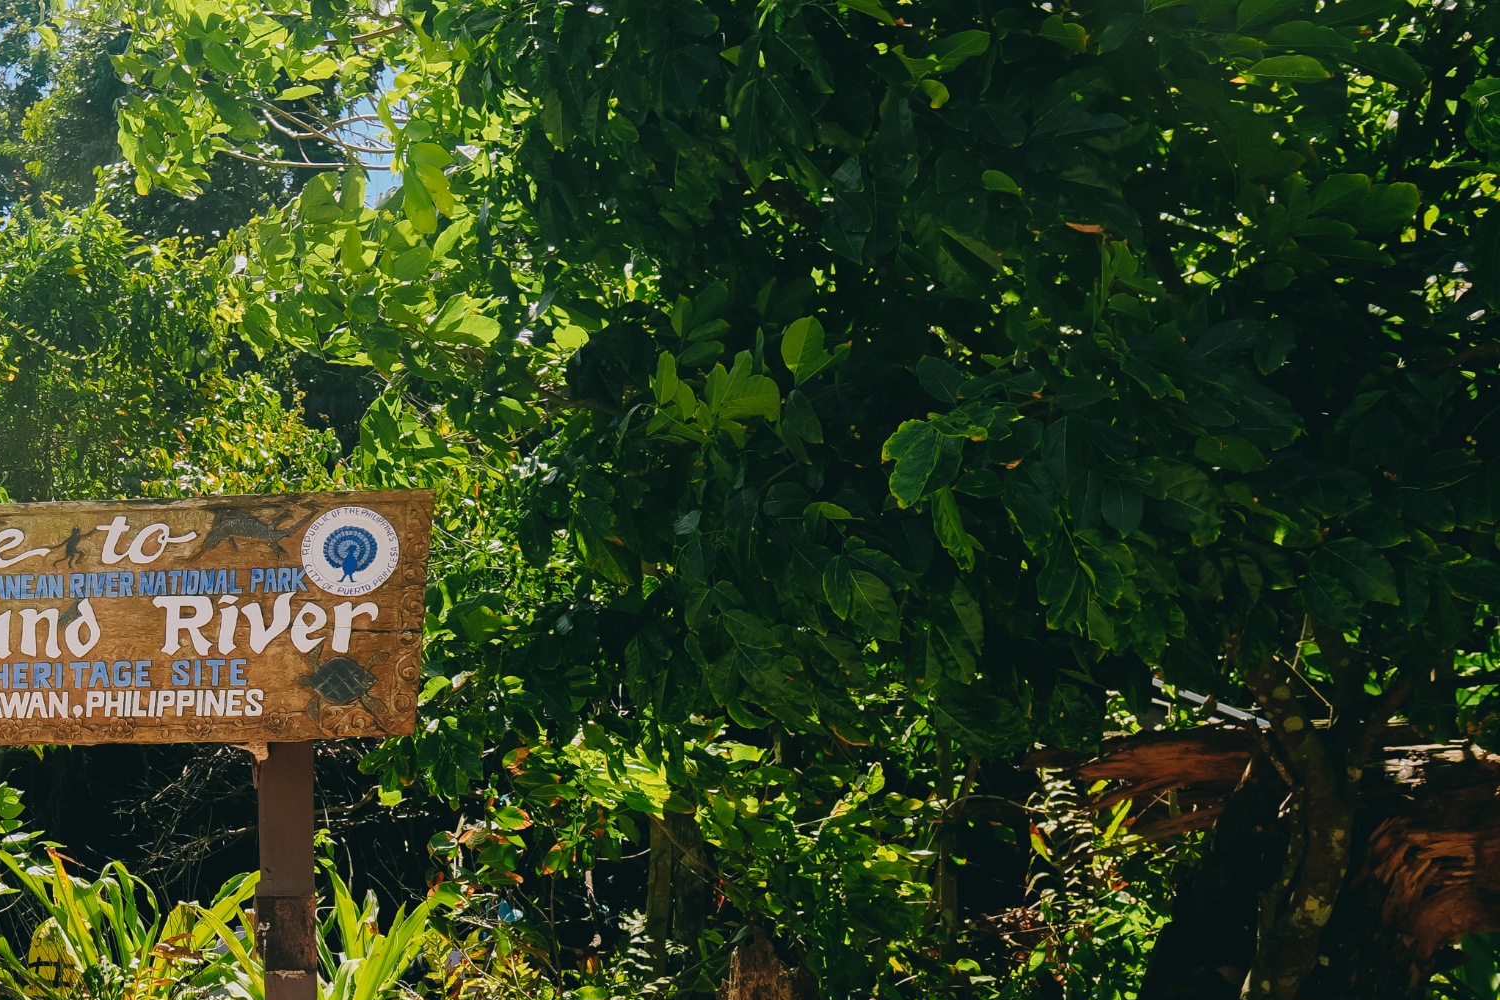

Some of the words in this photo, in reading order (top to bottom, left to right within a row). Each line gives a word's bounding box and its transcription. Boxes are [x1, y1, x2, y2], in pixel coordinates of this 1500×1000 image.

[96, 516, 198, 564] to
[302, 514, 332, 556] REPUBLIC
[332, 508, 342, 518] OF
[343, 507, 360, 516] THE
[360, 509, 397, 542] PHILIPPINES
[69, 571, 134, 599] RIVER
[138, 568, 242, 596] NATIONAL
[251, 567, 309, 594] PARK
[304, 563, 323, 583] CITY
[321, 582, 334, 591] OF
[336, 584, 372, 596] PUERTO
[373, 546, 399, 587] PRINCESA
[152, 592, 379, 657] River
[172, 658, 248, 687] SITE
[87, 689, 264, 717] PHILIPPINES
